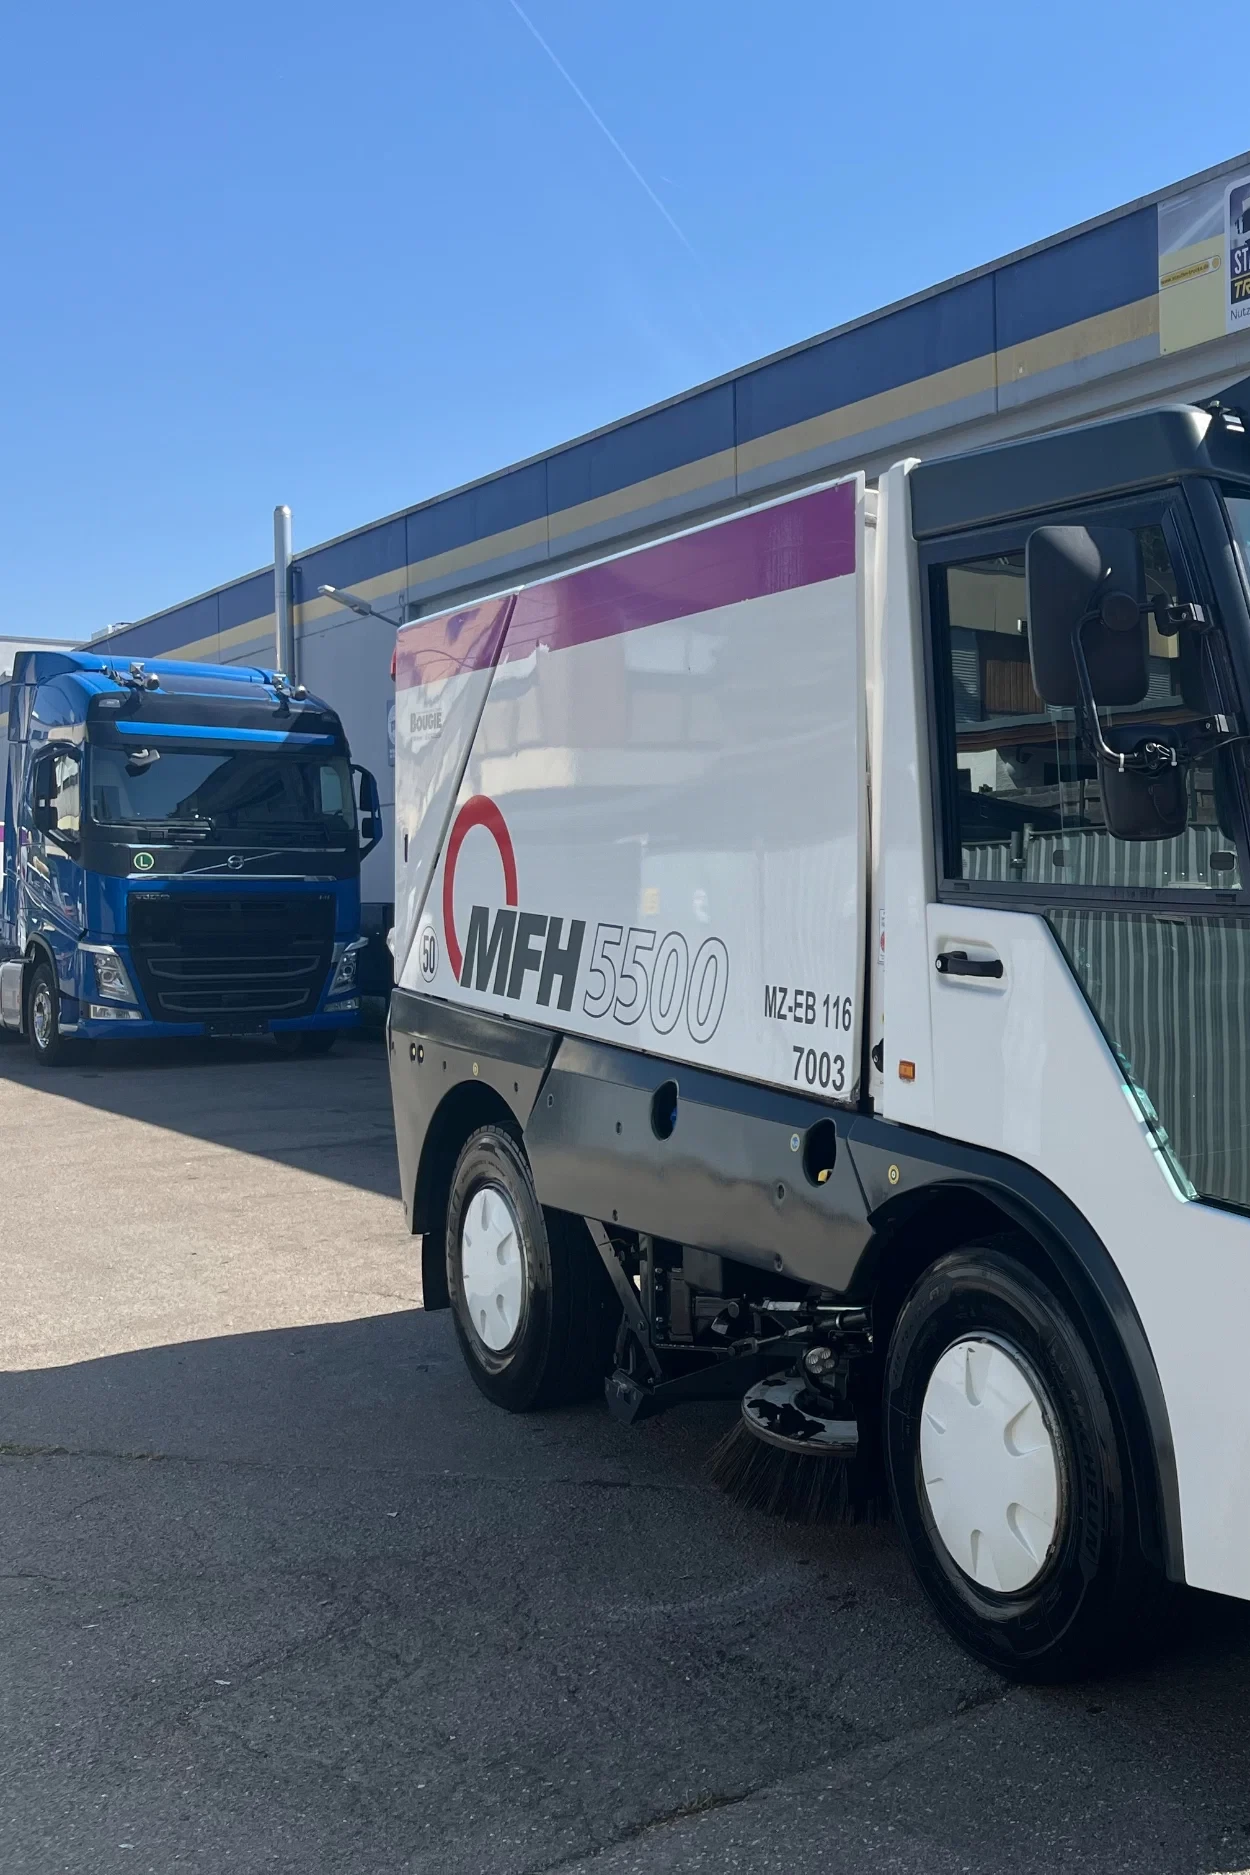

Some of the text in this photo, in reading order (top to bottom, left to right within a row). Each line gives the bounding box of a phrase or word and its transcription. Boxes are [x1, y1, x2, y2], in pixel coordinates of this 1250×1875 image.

[410, 712, 442, 733] BOUGIE
[422, 935, 436, 974] 50
[460, 905, 729, 1043] MFH 5500
[764, 984, 852, 1032] MZ-EB 116
[793, 1045, 845, 1092] 7003
